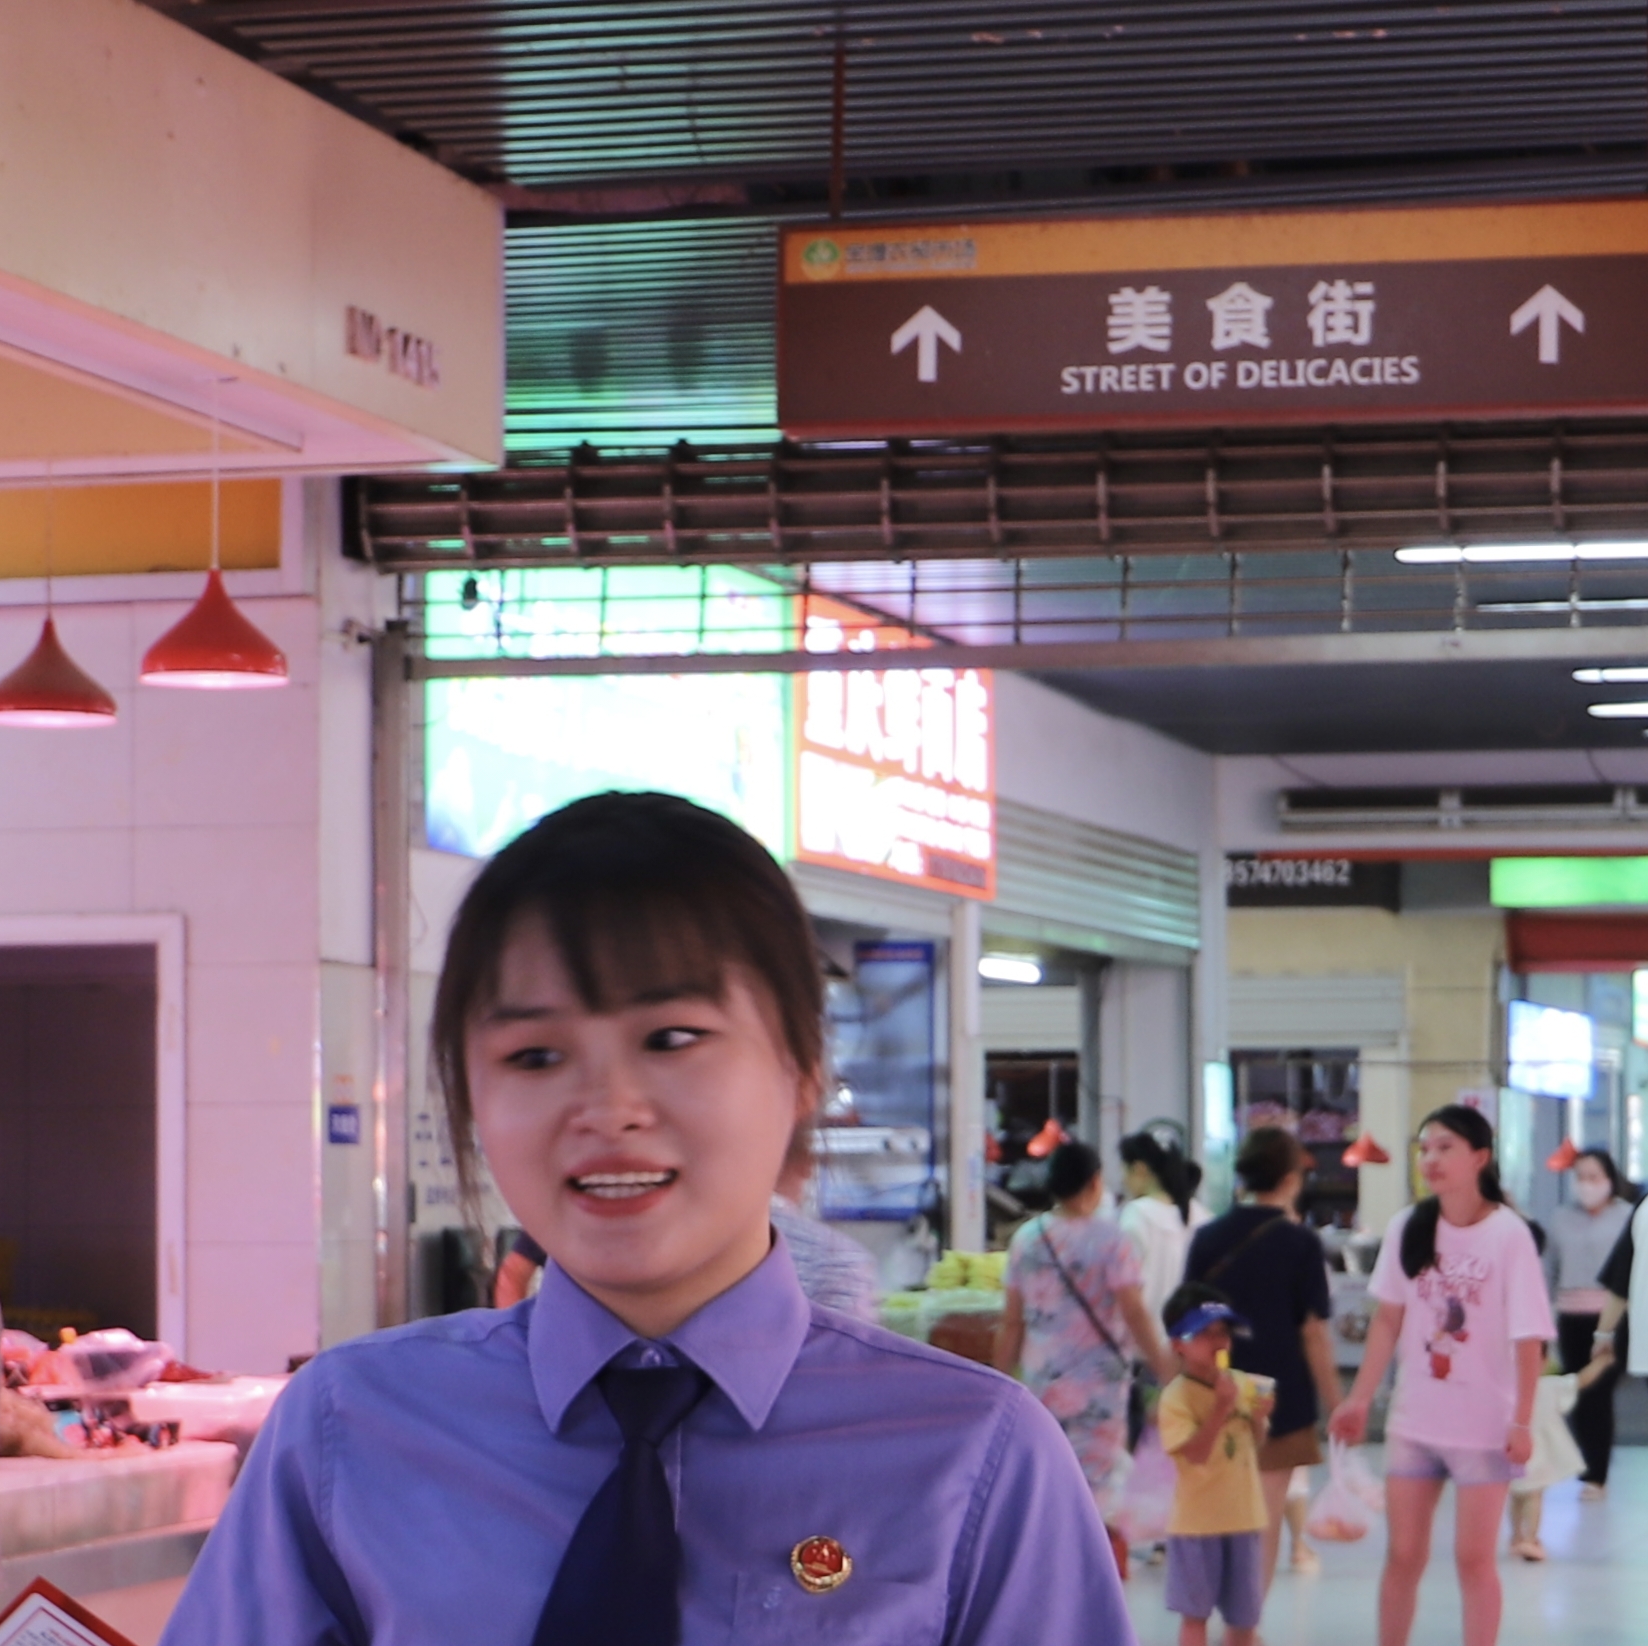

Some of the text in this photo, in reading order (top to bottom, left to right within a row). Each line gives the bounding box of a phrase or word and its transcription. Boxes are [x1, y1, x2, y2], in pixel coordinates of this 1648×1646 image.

[1106, 279, 1376, 354] 美食街
[1060, 356, 1421, 394] STREET OF DELICACIES
